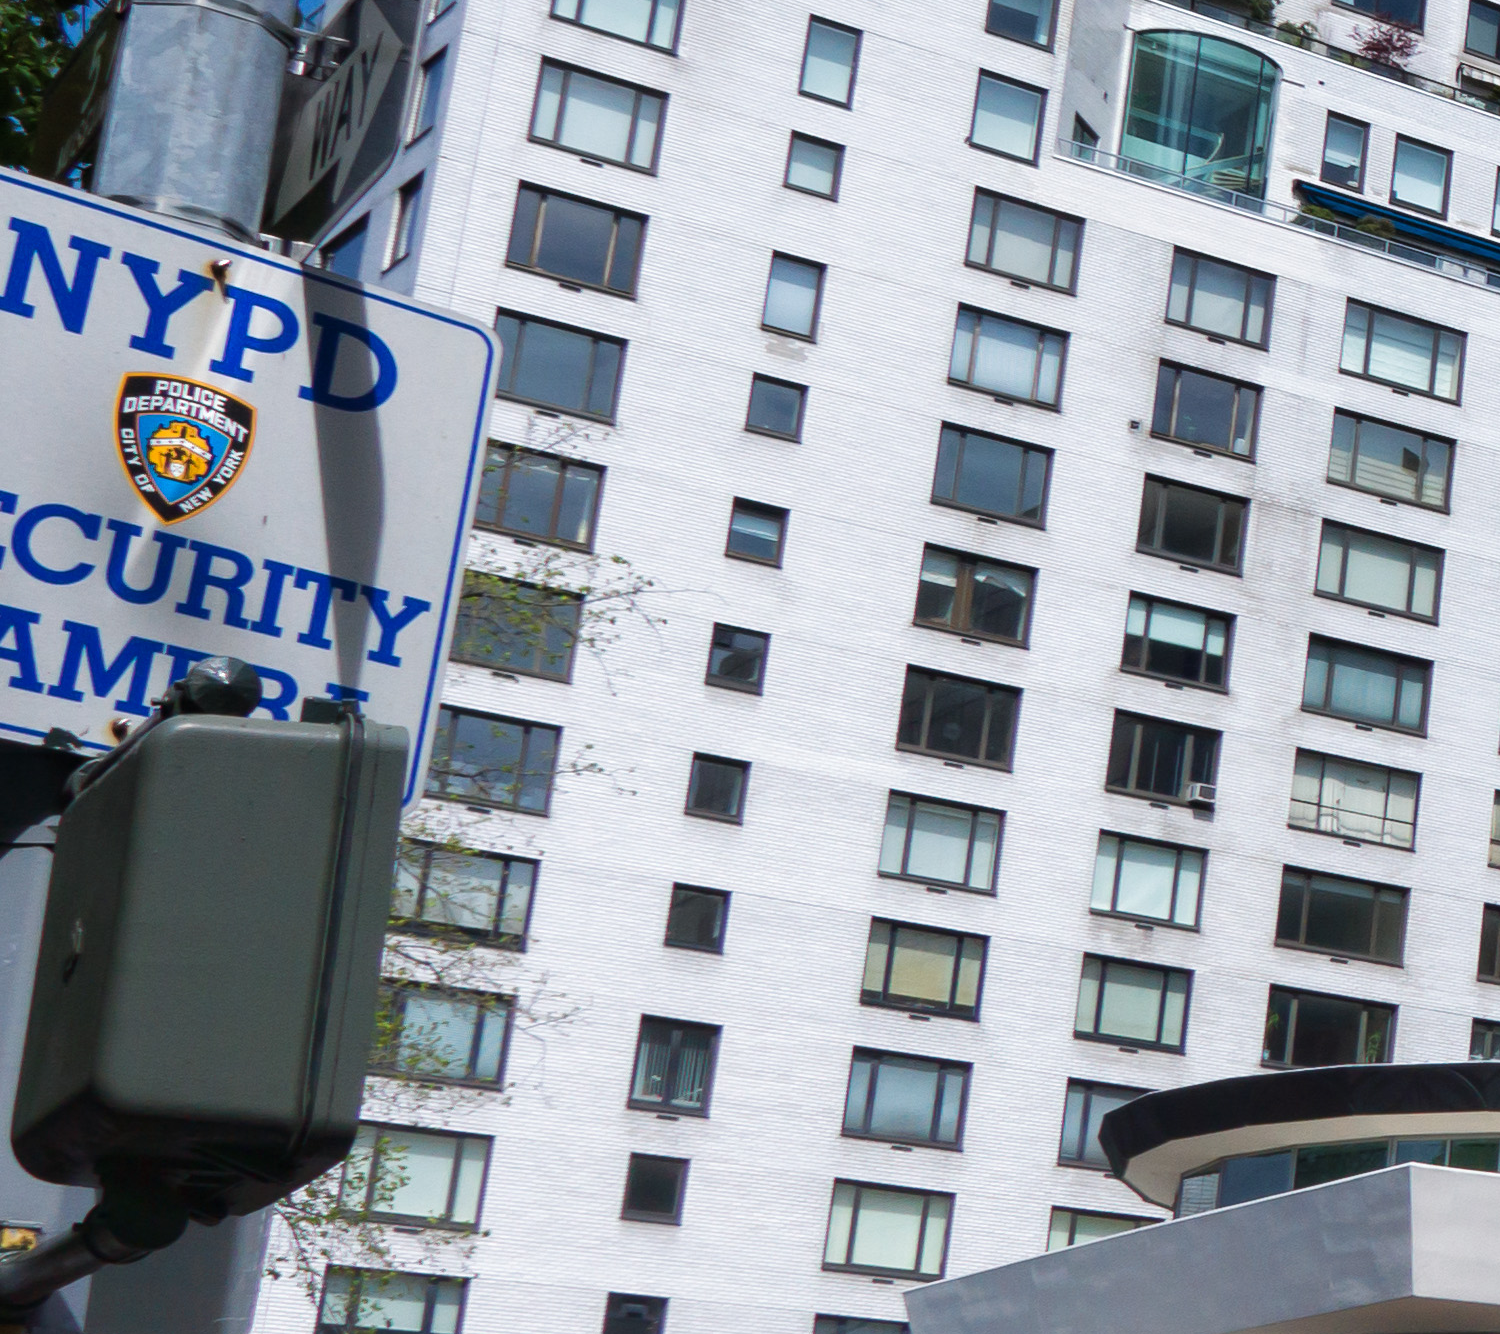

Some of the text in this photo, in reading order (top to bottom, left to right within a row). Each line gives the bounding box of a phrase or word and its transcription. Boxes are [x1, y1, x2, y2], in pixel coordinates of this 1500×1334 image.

[0, 217, 399, 413] NYPD
[122, 396, 249, 443] DEPARTMENT
[154, 380, 228, 413] POLICE
[121, 427, 156, 494] CITY OF
[178, 448, 245, 514] NEW YORK
[0, 489, 432, 669] CURITY
